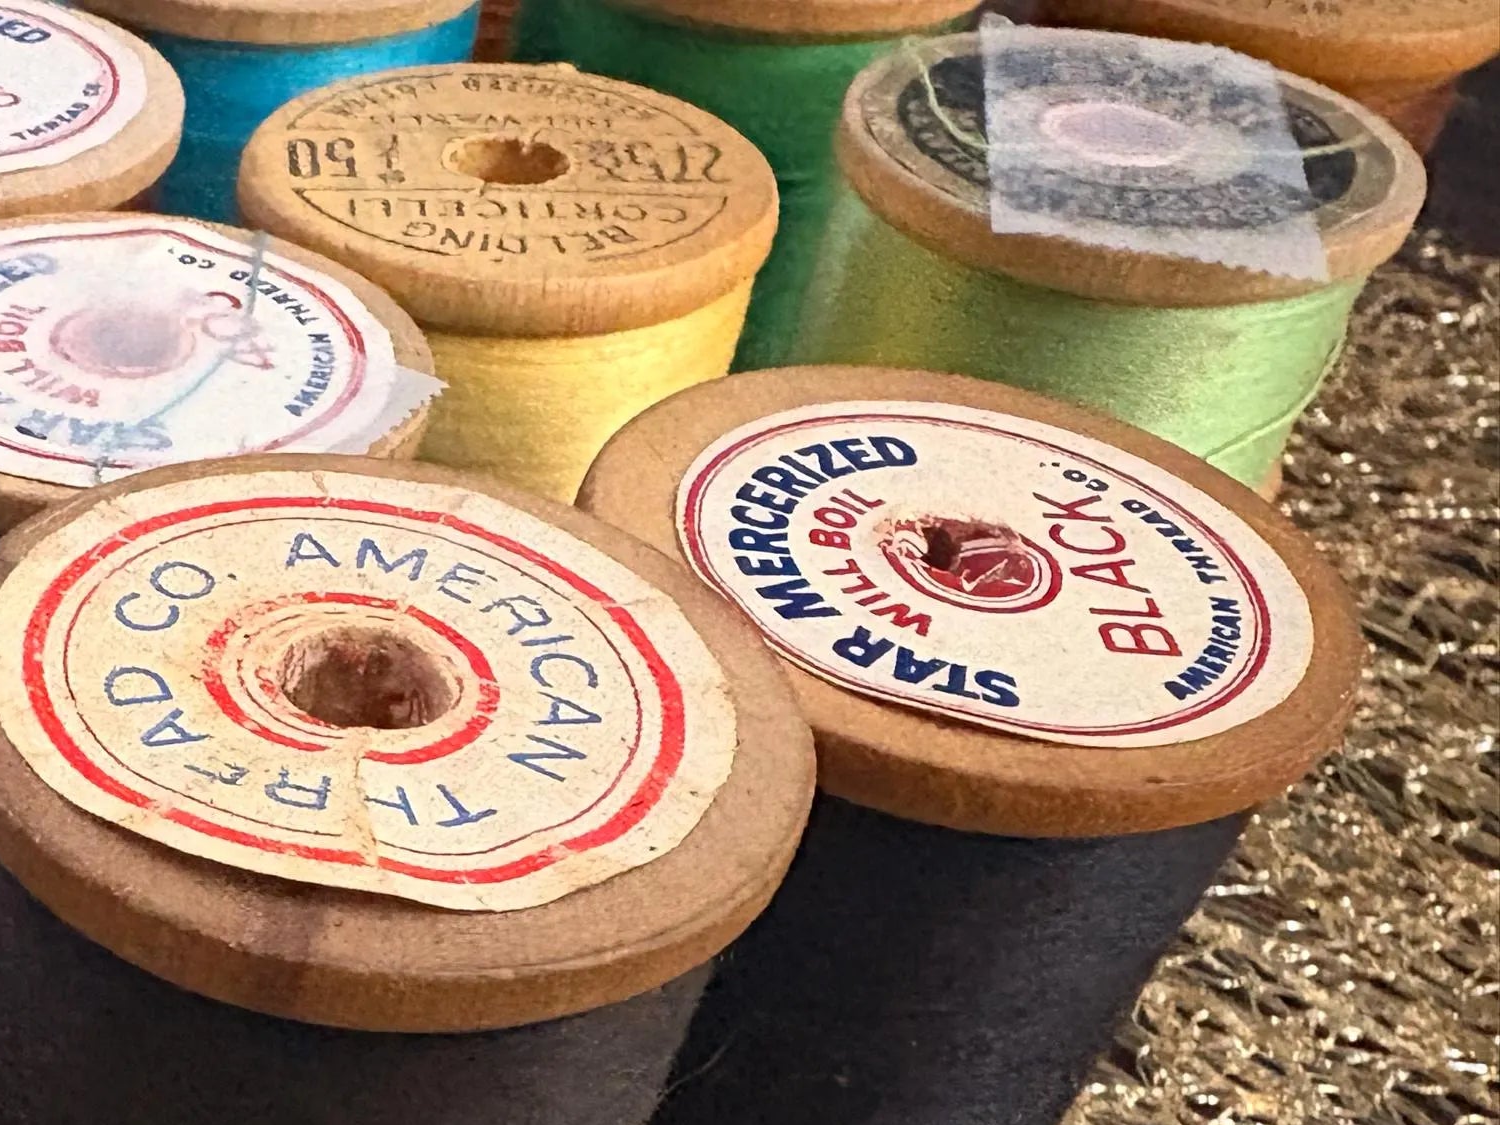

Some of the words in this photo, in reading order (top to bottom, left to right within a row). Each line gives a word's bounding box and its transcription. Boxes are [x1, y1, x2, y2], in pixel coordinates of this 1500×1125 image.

[287, 137, 357, 180] 50
[349, 197, 687, 223] CORTICELLI
[401, 220, 638, 256] BELDING
[284, 333, 336, 417] AMERICAN
[728, 435, 920, 622] MERCERIZED
[808, 488, 887, 552] BOIL
[1120, 500, 1229, 584] THREAD
[115, 561, 237, 632] CO.
[823, 566, 933, 638] WILL
[1032, 491, 1184, 658] BLACK
[285, 532, 604, 784] AMERICAN
[832, 625, 1021, 708] STAR
[1163, 596, 1242, 701] AMERICAN
